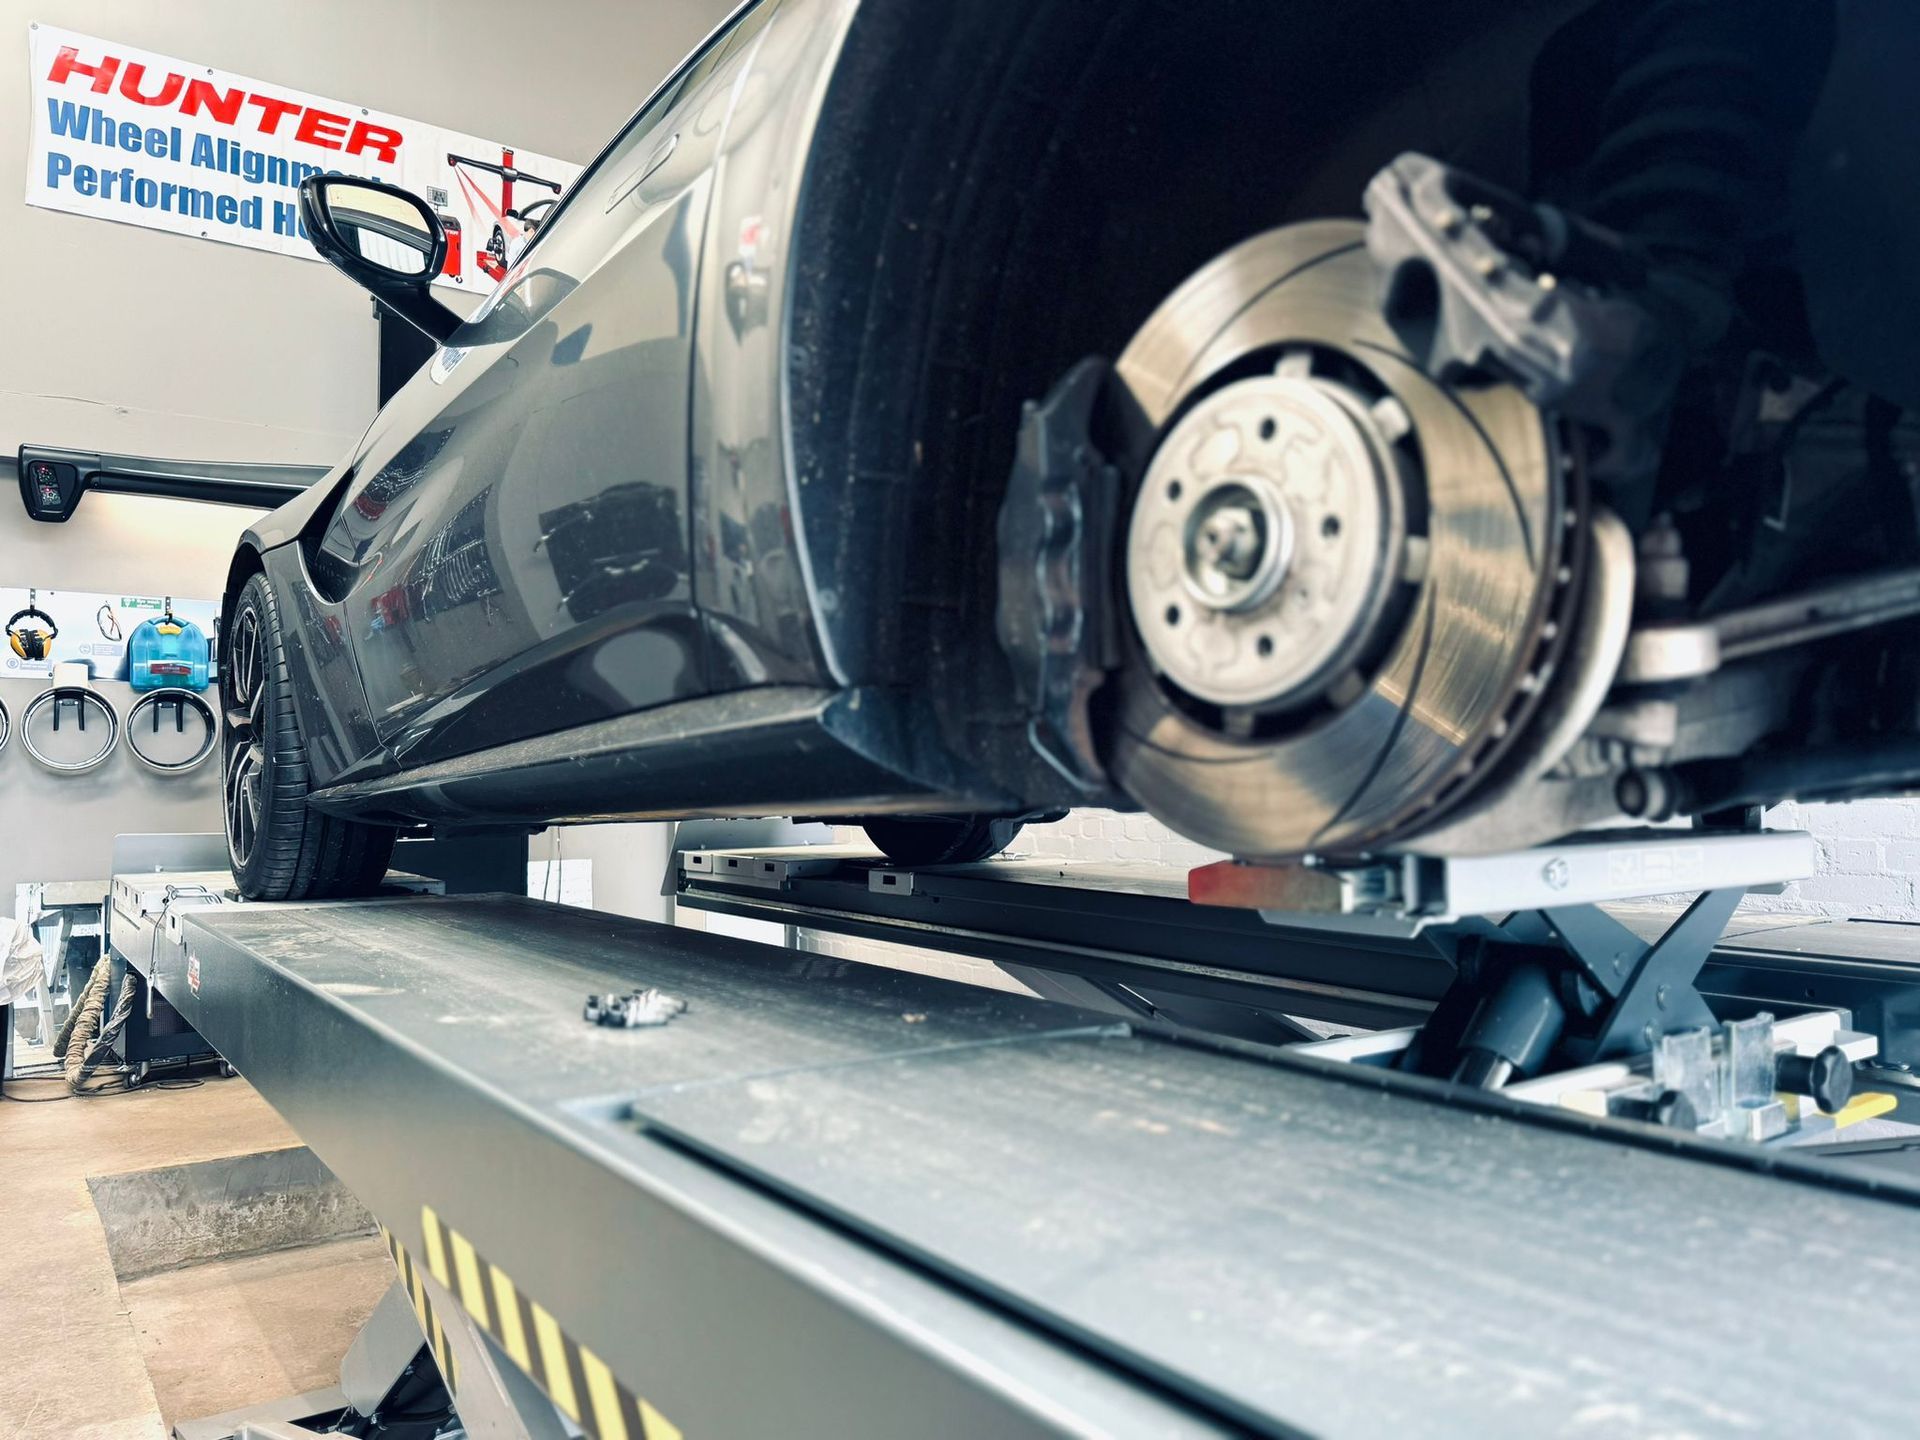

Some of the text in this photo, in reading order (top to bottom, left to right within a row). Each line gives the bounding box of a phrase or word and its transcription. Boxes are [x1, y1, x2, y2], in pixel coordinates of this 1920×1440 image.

[47, 46, 403, 164] HUNTER
[47, 97, 181, 162] Wheel
[47, 151, 263, 231] Performed
